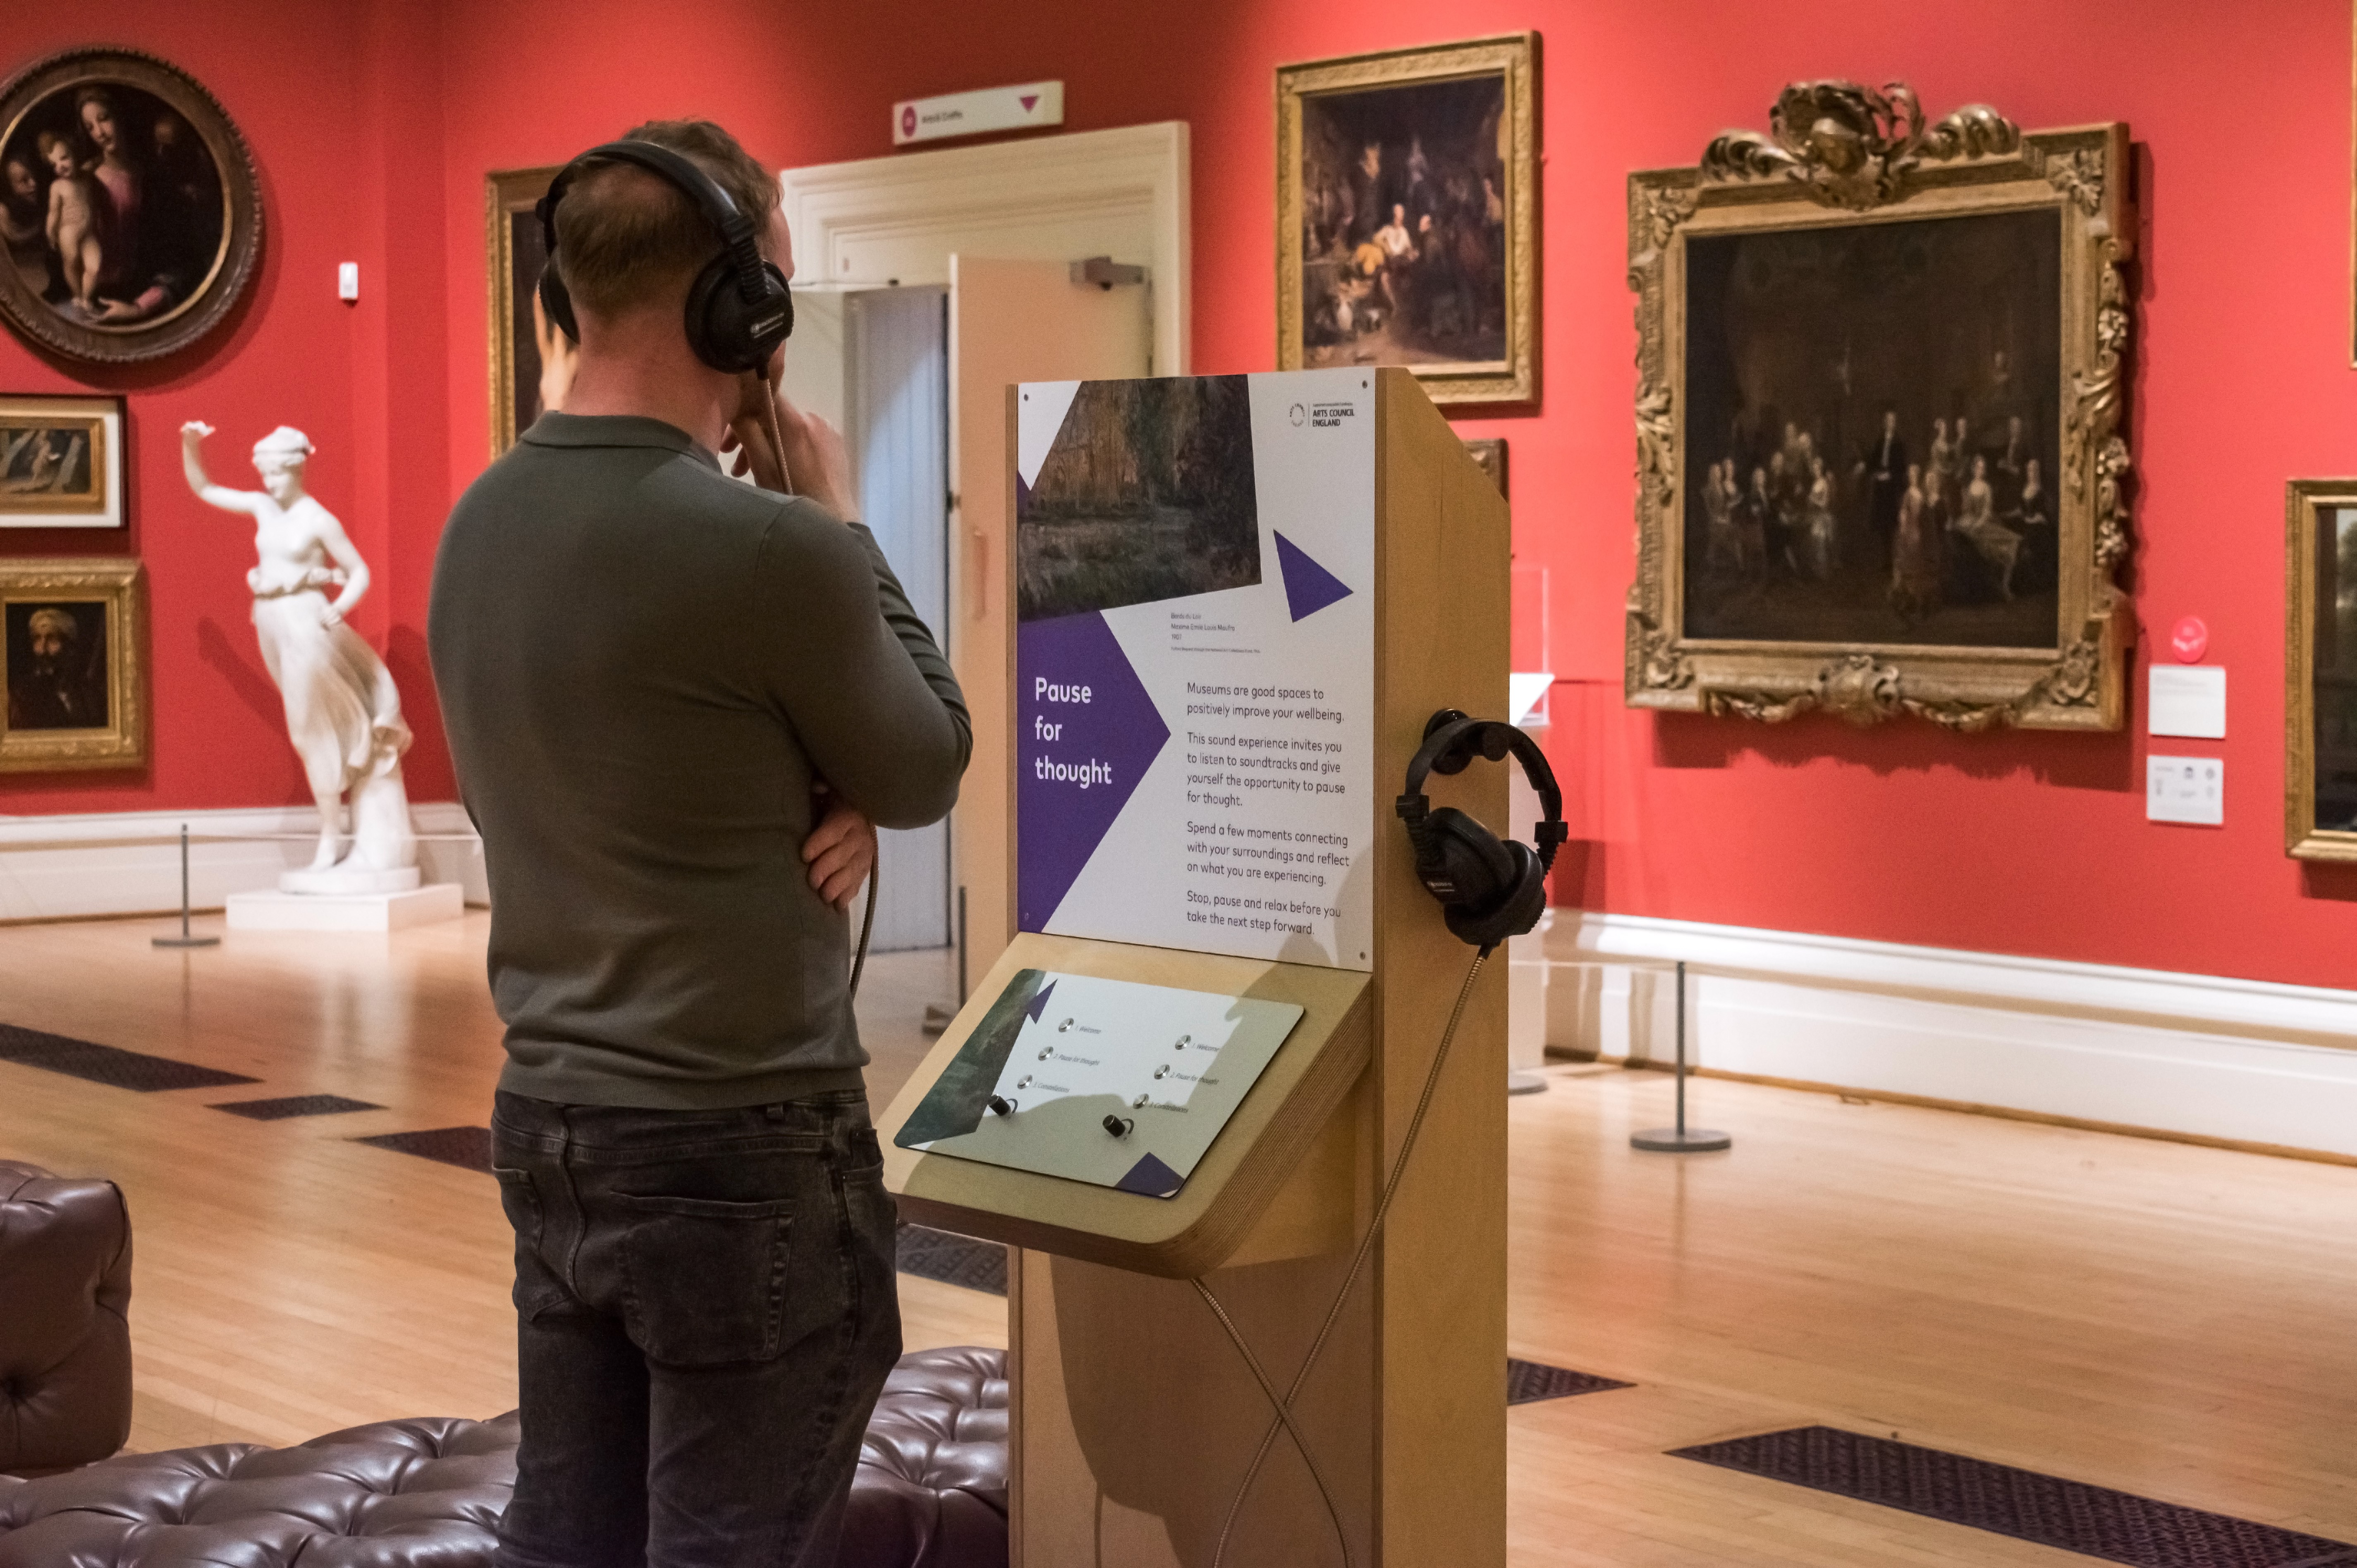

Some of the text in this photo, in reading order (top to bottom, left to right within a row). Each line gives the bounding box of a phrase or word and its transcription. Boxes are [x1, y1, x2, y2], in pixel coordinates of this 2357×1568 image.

[1312, 419, 1341, 427] ENGLAND
[1329, 408, 1355, 417] COUNCIL
[1036, 677, 1092, 704] Pause
[1187, 682, 1324, 700] Museums are good spaces to
[1187, 704, 1344, 724] positively improve your wellbeing.
[1035, 715, 1063, 741] for
[1187, 732, 1341, 754] This sound experience invites you
[1035, 755, 1112, 789] thought
[1187, 753, 1340, 775] to listen to soundtracks and give
[1187, 773, 1345, 794] yourself the opportunity to pause
[1187, 790, 1242, 808] for thought.
[1187, 821, 1348, 849] Spend a few moments connecting
[1187, 842, 1349, 866] with your surroundings and reflect
[1187, 862, 1326, 887] on what you are experiencing.
[1187, 890, 1341, 919] Stop, pause and relax before you
[1187, 911, 1315, 935] take the next step forward.
[1079, 1026, 1102, 1034] Welcome
[1196, 1043, 1220, 1052] Welcome
